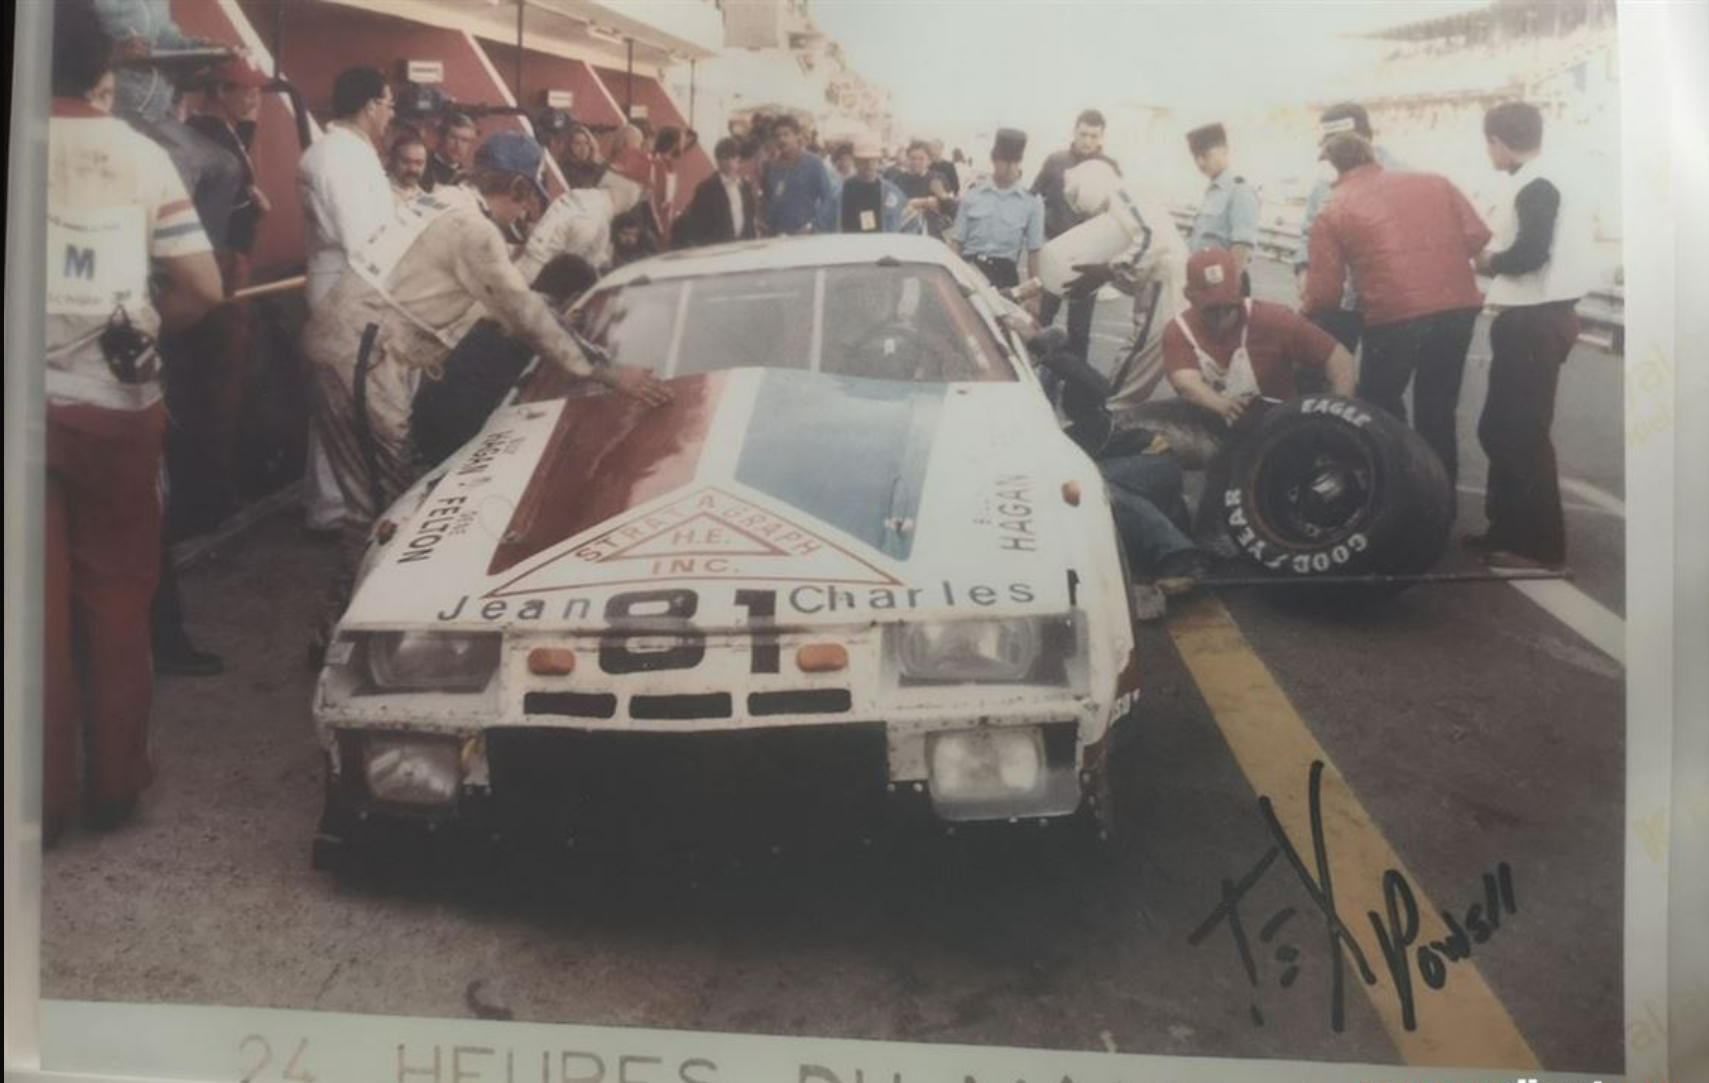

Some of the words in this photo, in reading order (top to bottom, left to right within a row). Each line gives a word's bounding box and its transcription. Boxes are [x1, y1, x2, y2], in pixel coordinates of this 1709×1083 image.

[64, 243, 95, 281] M
[397, 496, 468, 564] FELTON
[995, 473, 1037, 552] HAGAN
[652, 556, 740, 575] INC.
[437, 595, 591, 621] Jean
[598, 588, 782, 675] 81
[789, 580, 1035, 614] Charles
[239, 1034, 315, 1083] 24
